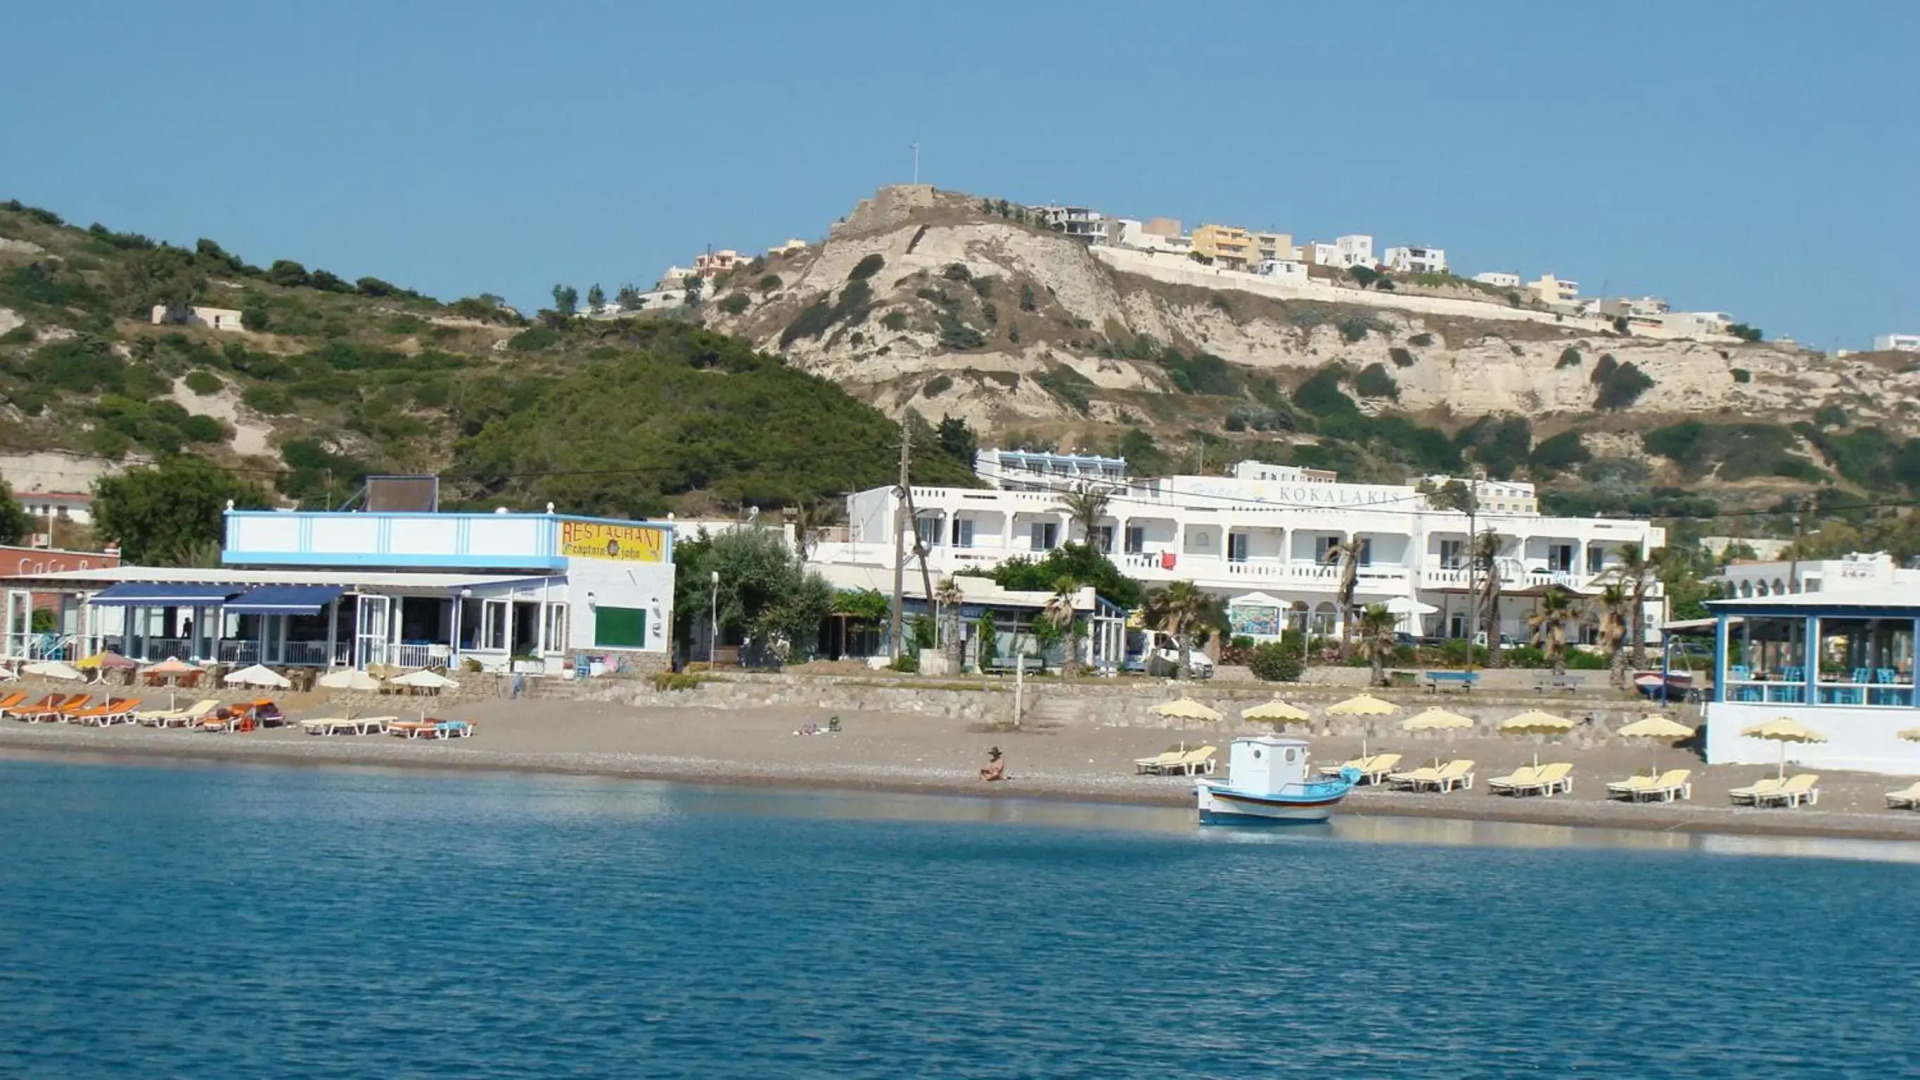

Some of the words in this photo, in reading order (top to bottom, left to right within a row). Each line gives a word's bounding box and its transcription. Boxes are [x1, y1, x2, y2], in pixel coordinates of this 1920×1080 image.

[1280, 486, 1400, 505] KOKALAKIS
[562, 521, 661, 551] RESTAURANT
[572, 544, 605, 558] captain
